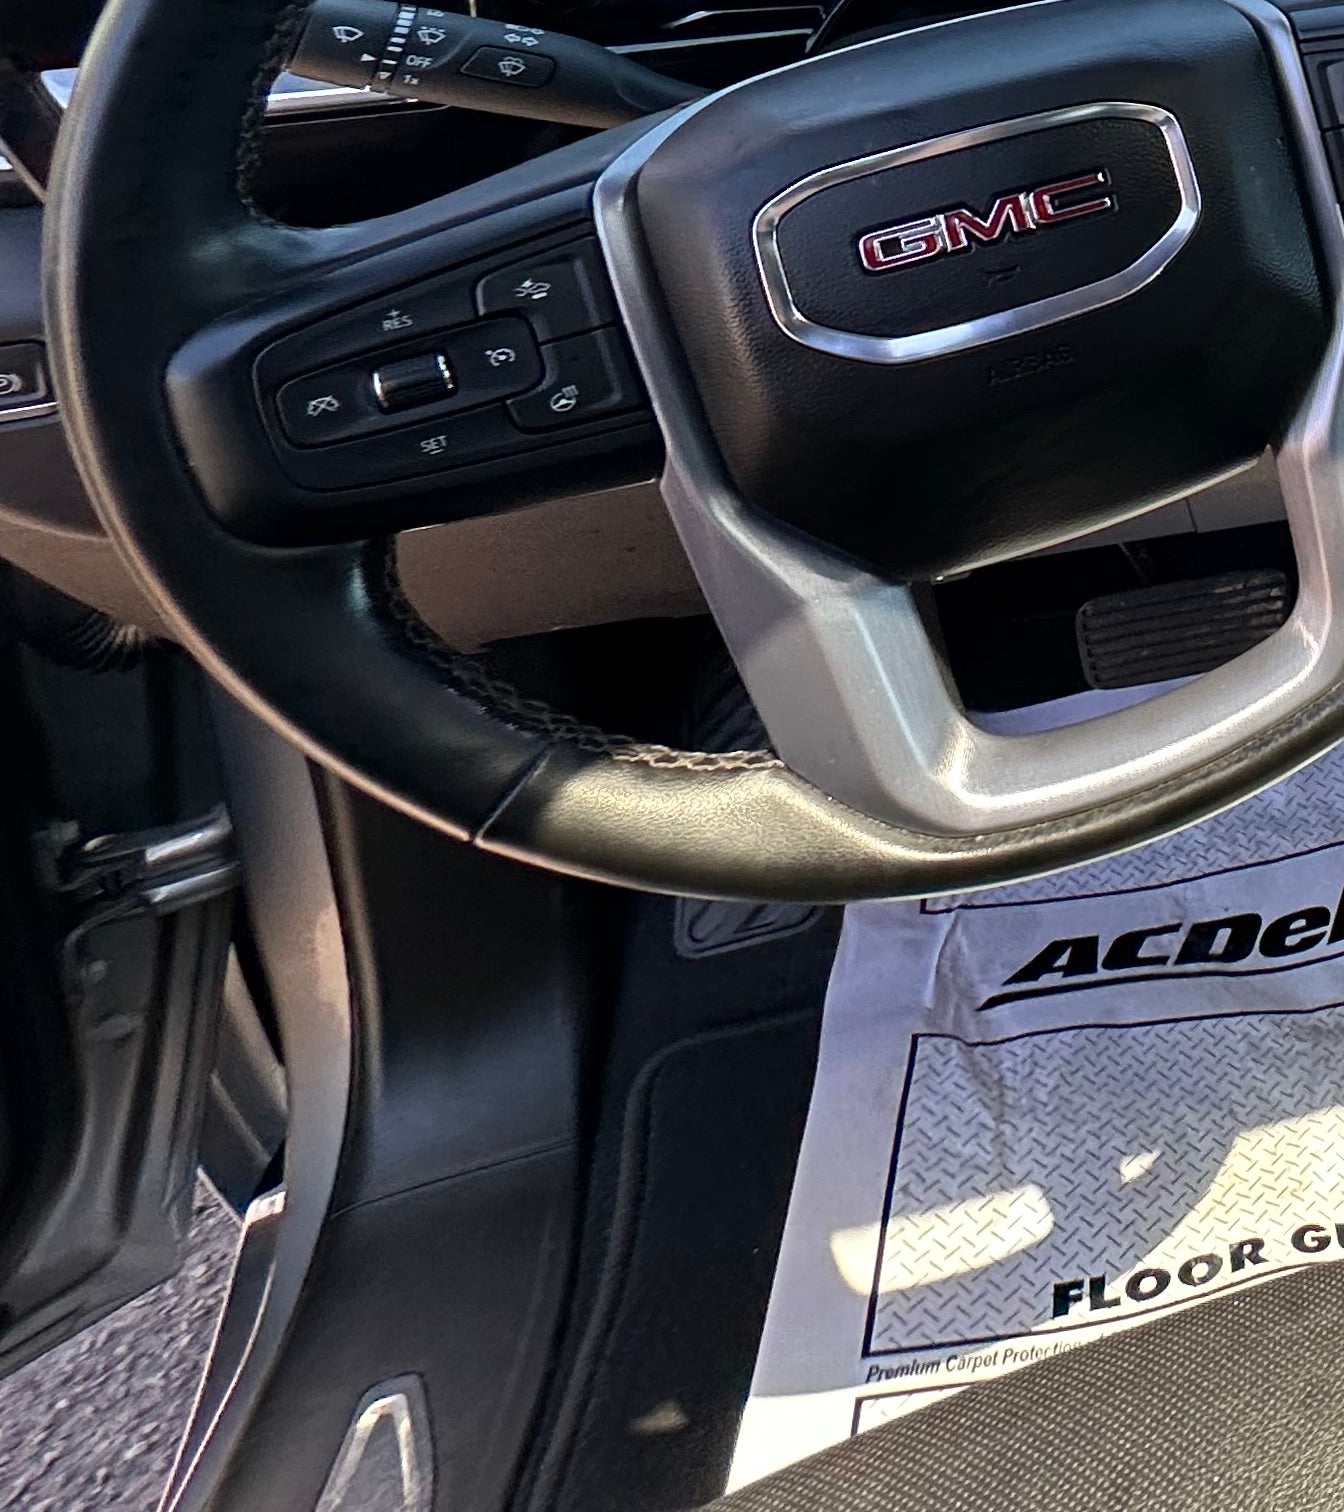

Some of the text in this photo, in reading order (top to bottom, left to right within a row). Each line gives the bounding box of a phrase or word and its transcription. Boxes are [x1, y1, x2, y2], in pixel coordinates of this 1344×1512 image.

[406, 54, 433, 68] OFF
[403, 74, 420, 85] 1x
[858, 171, 1112, 271] GMC
[382, 315, 413, 331] RES
[420, 435, 447, 453] SET
[1052, 1236, 1270, 1320] FLOOR
[866, 1361, 941, 1383] Premium
[946, 1350, 999, 1373] Carpet
